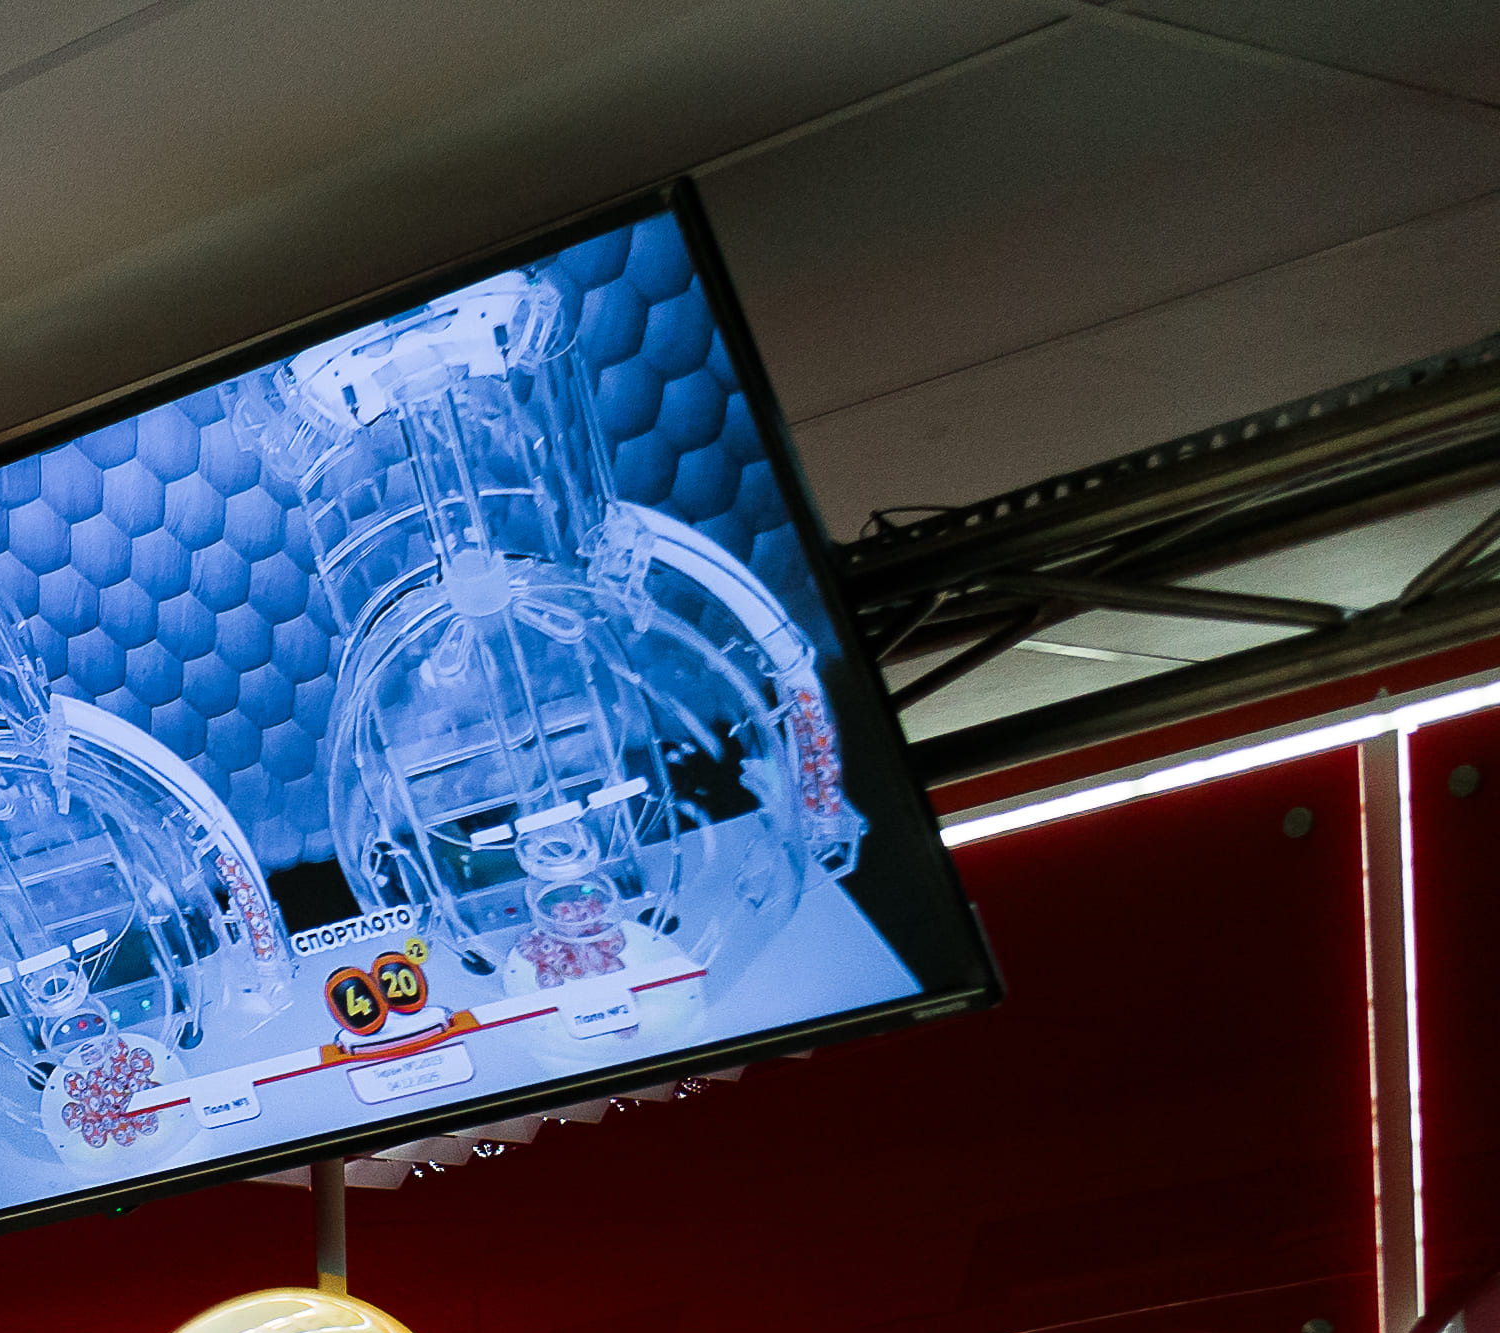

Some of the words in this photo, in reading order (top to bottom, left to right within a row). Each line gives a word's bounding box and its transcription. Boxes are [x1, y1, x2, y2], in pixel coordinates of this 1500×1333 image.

[295, 908, 411, 954] СПОРТЛОТО
[345, 985, 373, 1017] 4
[381, 968, 418, 998] 20
